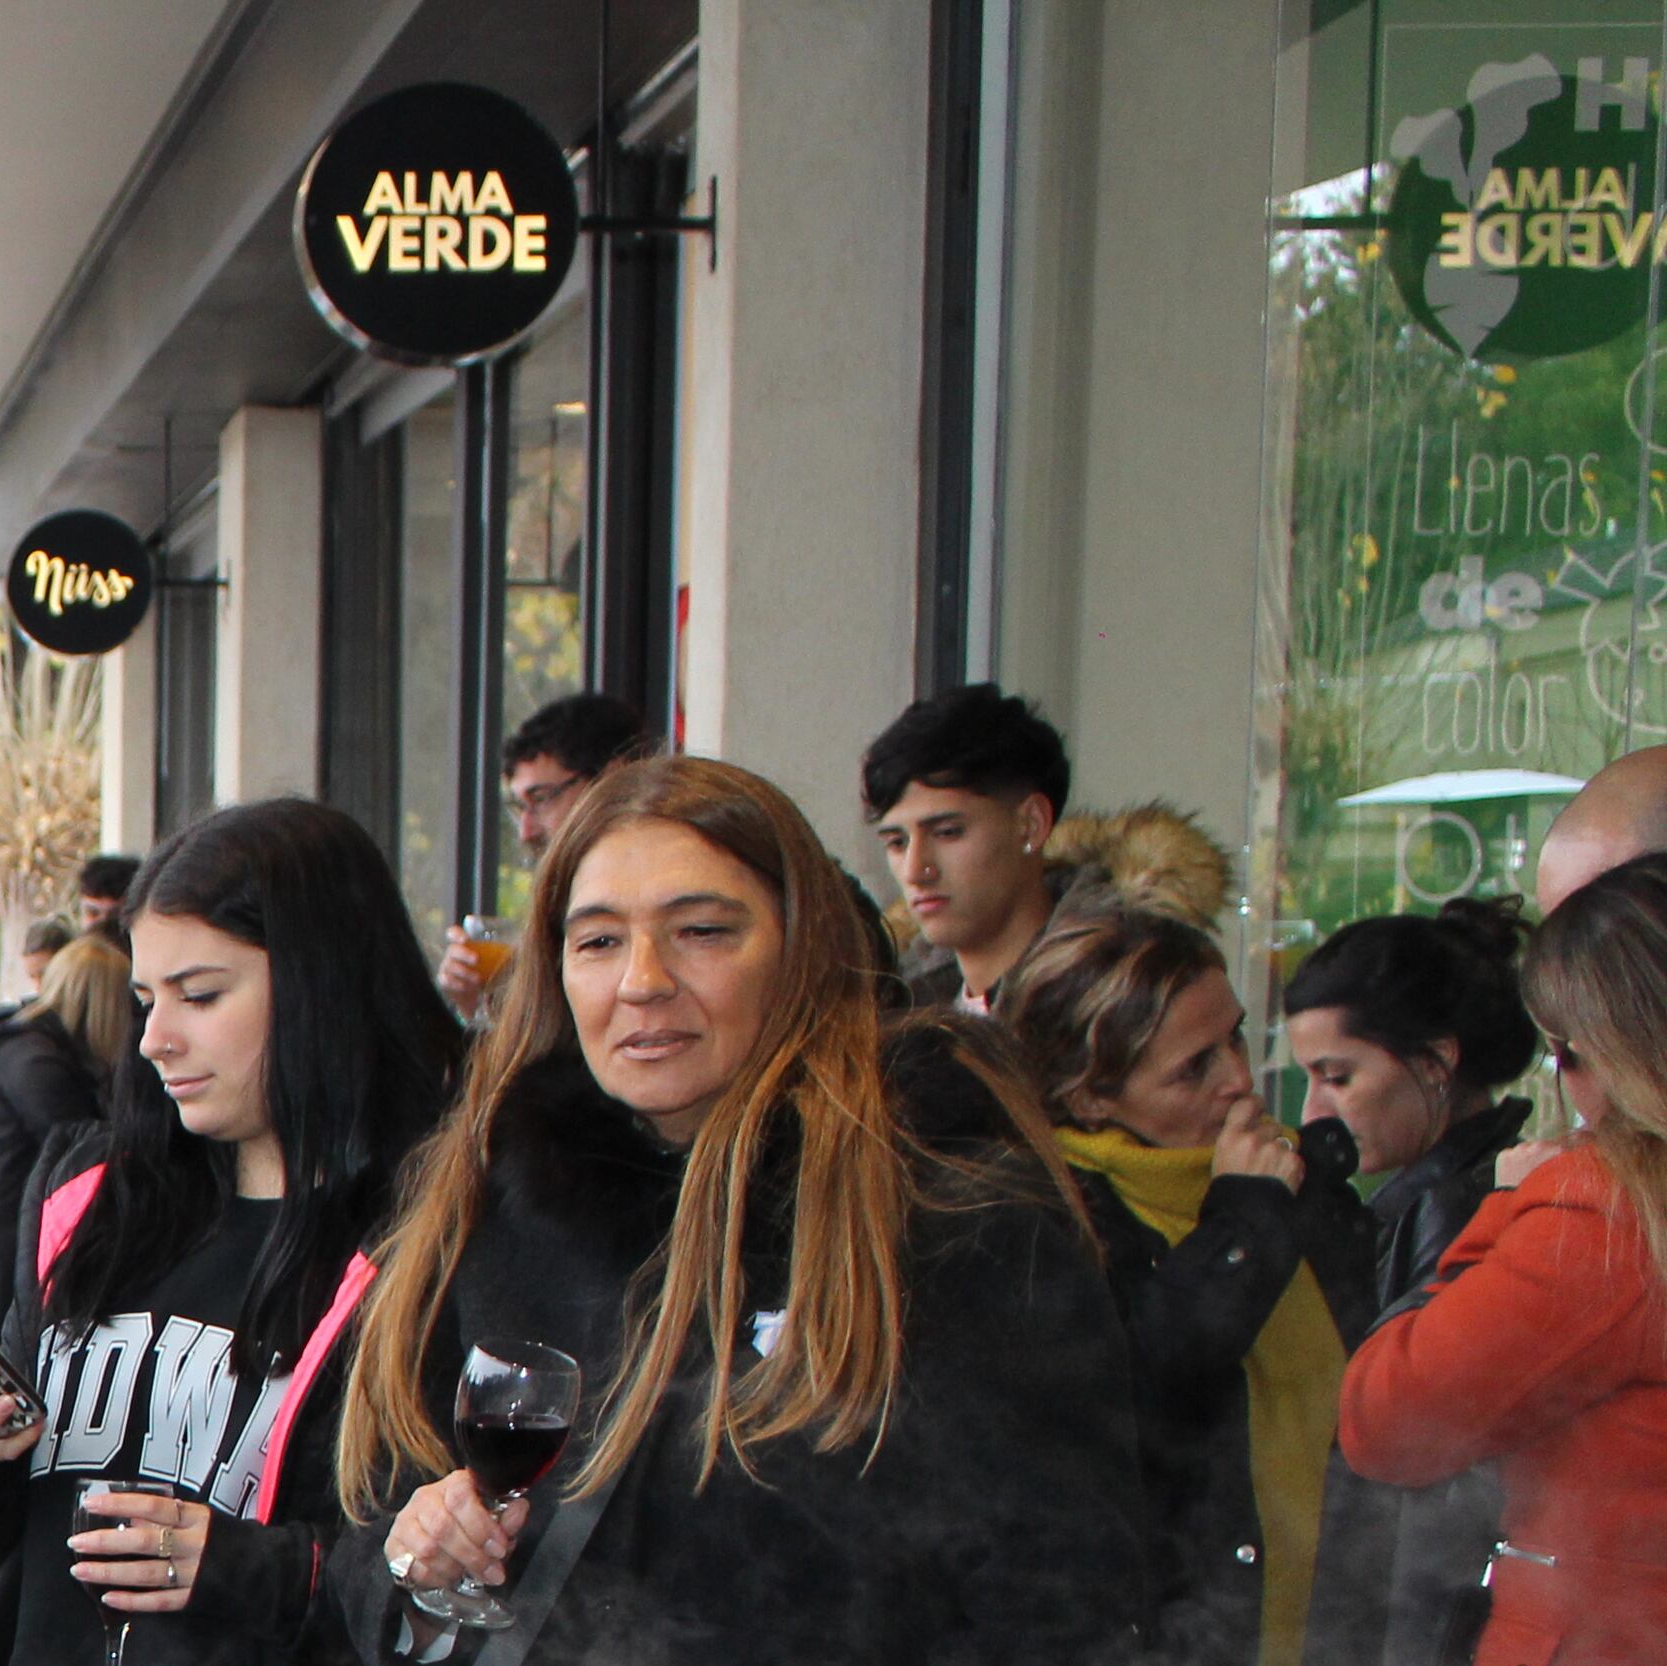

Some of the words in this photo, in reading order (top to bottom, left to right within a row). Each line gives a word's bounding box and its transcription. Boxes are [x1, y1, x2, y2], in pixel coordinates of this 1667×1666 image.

[362, 170, 515, 216] ALMA
[336, 214, 548, 273] VERDE
[1412, 418, 1602, 538] Llenas
[1417, 554, 1544, 632] de
[1422, 637, 1569, 757] color
